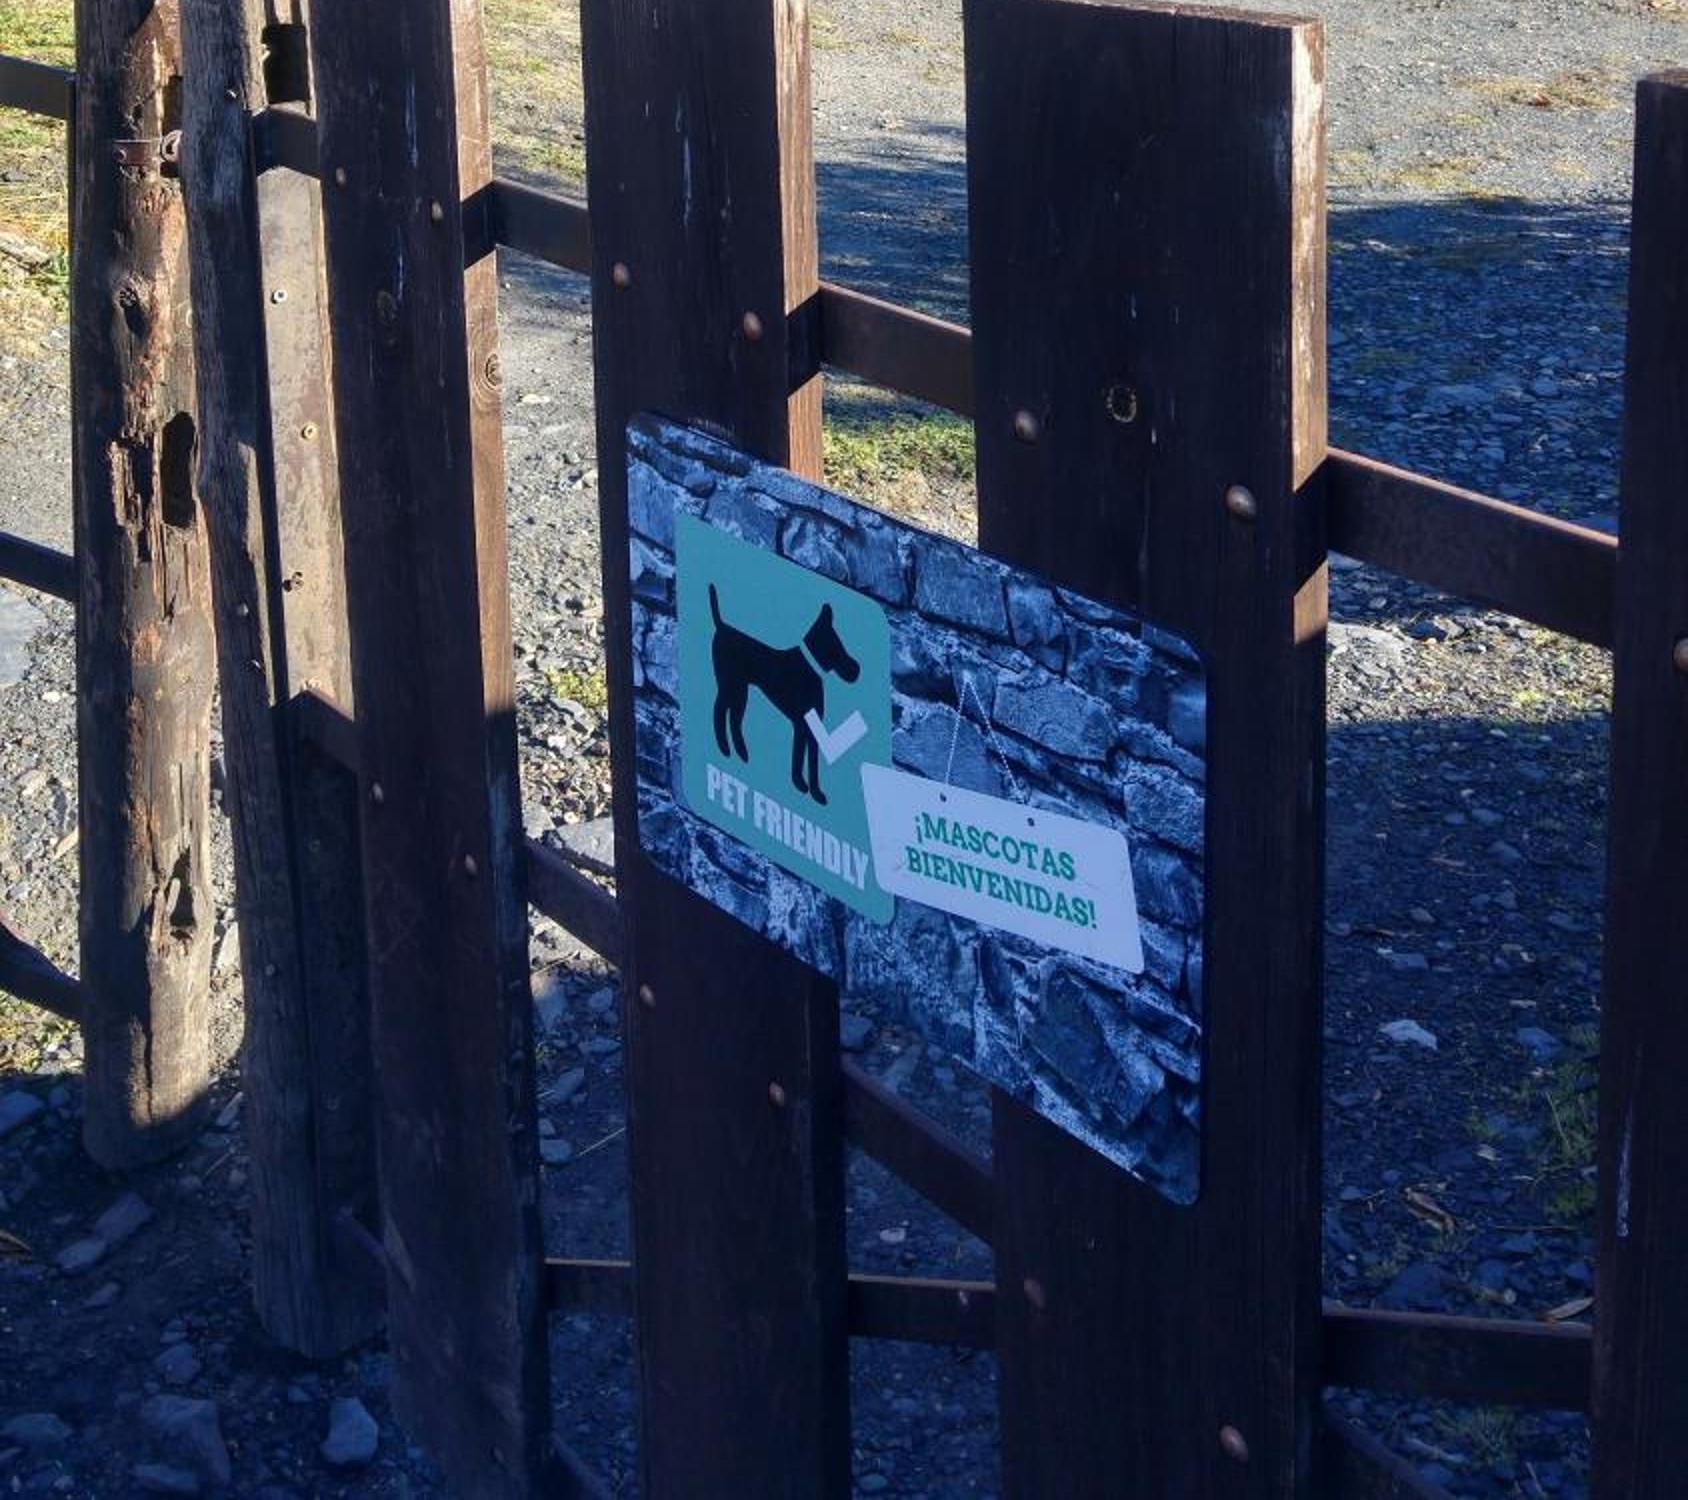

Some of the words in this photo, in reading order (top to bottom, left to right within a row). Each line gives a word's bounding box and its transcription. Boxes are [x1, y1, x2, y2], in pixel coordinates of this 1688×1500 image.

[706, 763, 749, 821] PET
[753, 790, 869, 891] FRIENDLY
[915, 811, 1076, 882] ¡MASCOTAS
[904, 845, 1098, 930] BIENVENIDAS!
